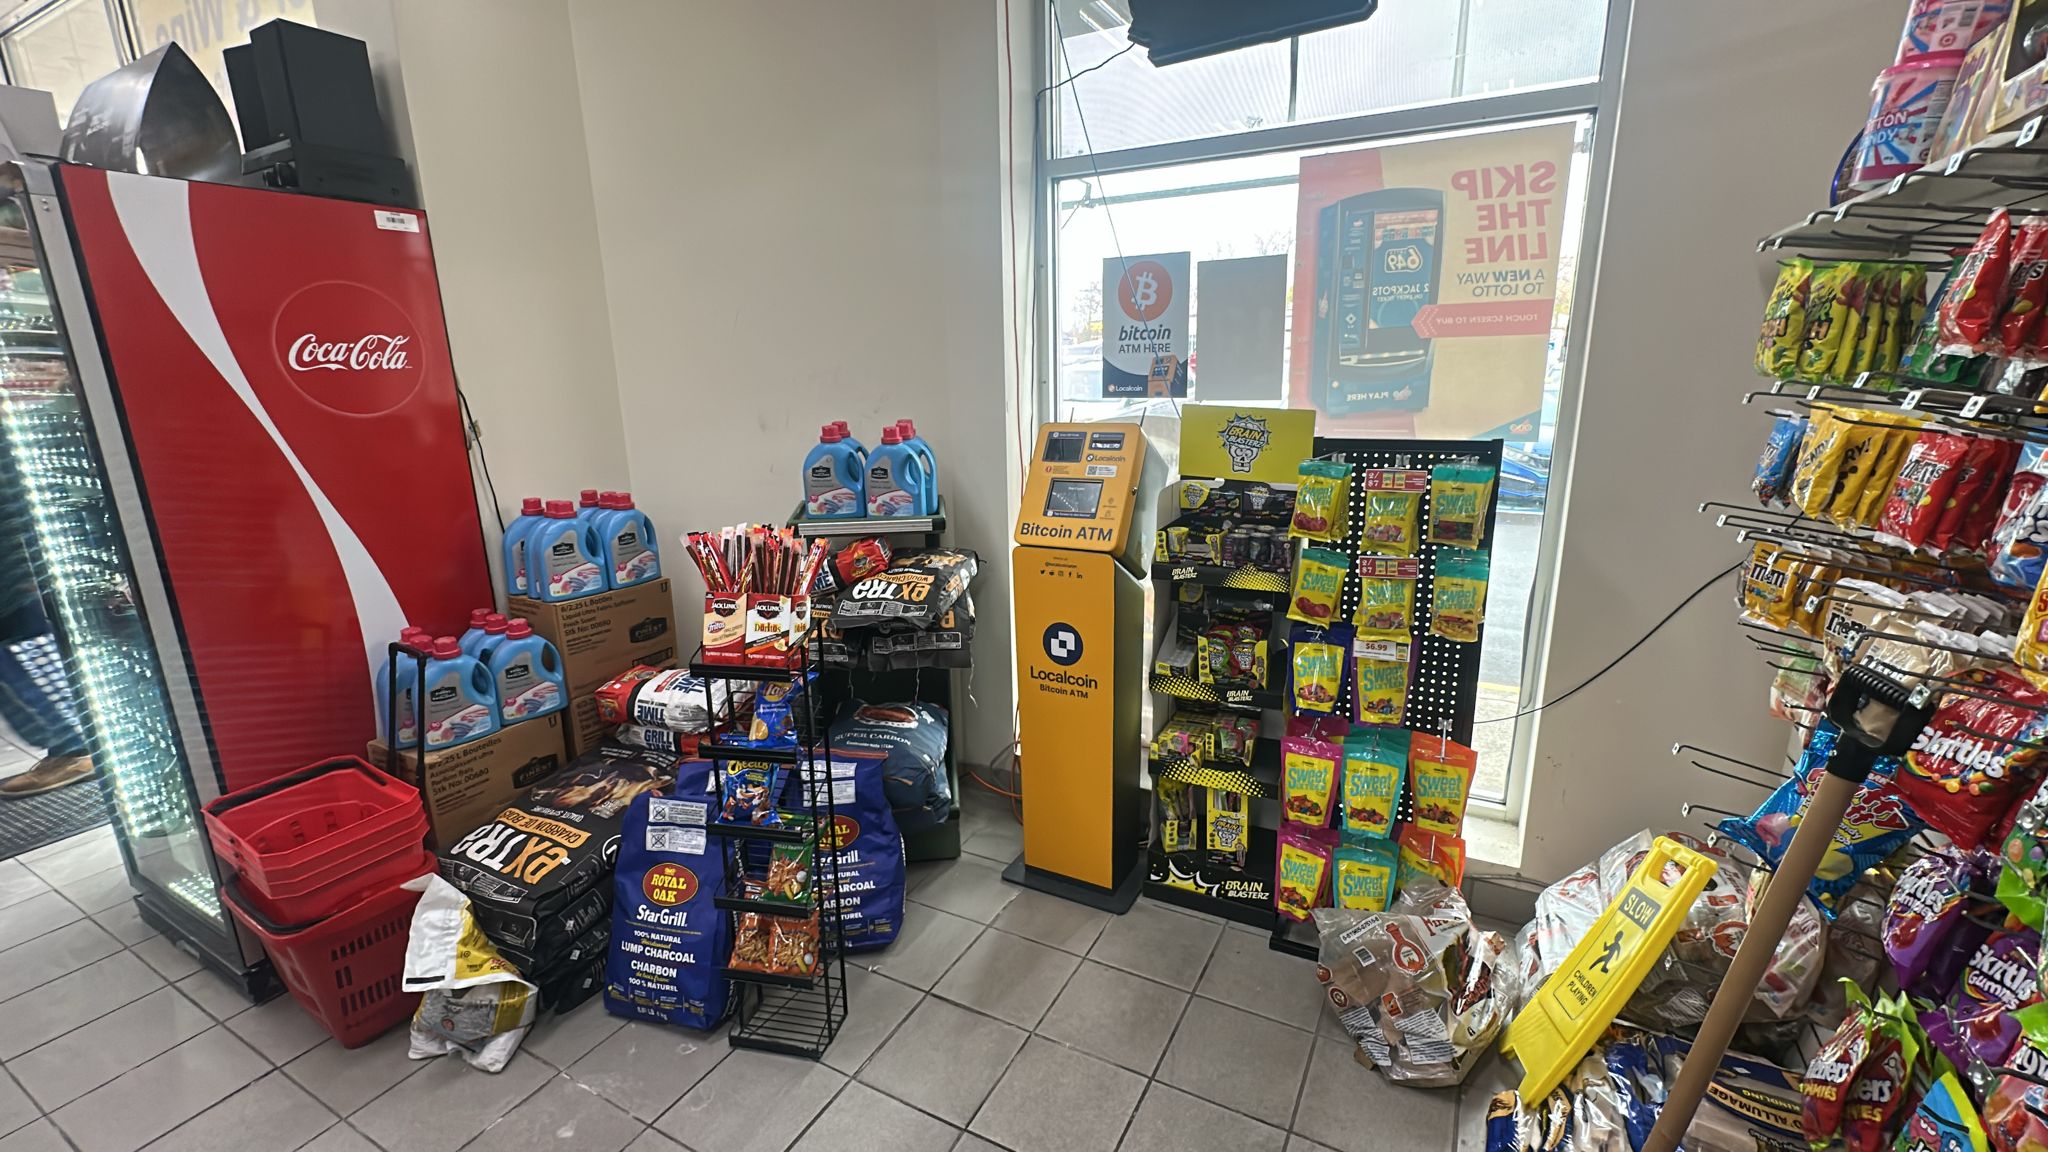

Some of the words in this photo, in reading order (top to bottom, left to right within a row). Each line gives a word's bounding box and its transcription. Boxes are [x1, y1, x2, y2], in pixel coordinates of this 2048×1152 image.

[1118, 324, 1171, 341] bitcoin
[288, 333, 410, 371] Coca-Cola
[1118, 344, 1141, 354] ATM
[1143, 343, 1171, 353] HERE
[1228, 426, 1262, 440] BRAIN
[1228, 435, 1265, 448] BLASTERZ
[1367, 479, 1379, 488] $7
[1020, 522, 1072, 539] Bitcoin
[1076, 526, 1113, 541] ATM
[1172, 566, 1195, 576] BRAIN
[755, 622, 781, 632] Doritos
[1030, 665, 1098, 689] Localcoin
[1040, 684, 1067, 696] Bitcoin
[1069, 689, 1089, 699] ATM
[1227, 690, 1250, 698] BRAIN
[644, 729, 672, 745] GRILL
[834, 733, 868, 742] SUPER
[869, 733, 912, 746] CARBON
[1910, 726, 2006, 779] Skittles
[1288, 767, 1327, 789] Sweet
[1350, 771, 1393, 796] Sweet
[1418, 773, 1462, 797] Sweet
[502, 809, 522, 824] BOIS
[521, 816, 535, 829] DE
[533, 820, 582, 844] CHARBON
[1281, 858, 1318, 880] Sweet
[651, 874, 687, 890] ROYAL
[1225, 880, 1264, 892] BRAIN
[1343, 873, 1383, 896] Sweet
[653, 888, 678, 902] OAK
[1228, 890, 1270, 900] BLASTERZ
[636, 904, 687, 927] StarGrill
[1624, 894, 1656, 925] SLOW
[634, 930, 650, 939] 100%
[650, 932, 682, 944] NATURAL
[621, 940, 644, 954] LUMP
[644, 946, 696, 964] CHARCOAL
[631, 960, 678, 978] CHARBON
[647, 981, 679, 992] NATUREL
[1573, 969, 1598, 998] CHILDREN
[1567, 981, 1589, 1006] PLAYING
